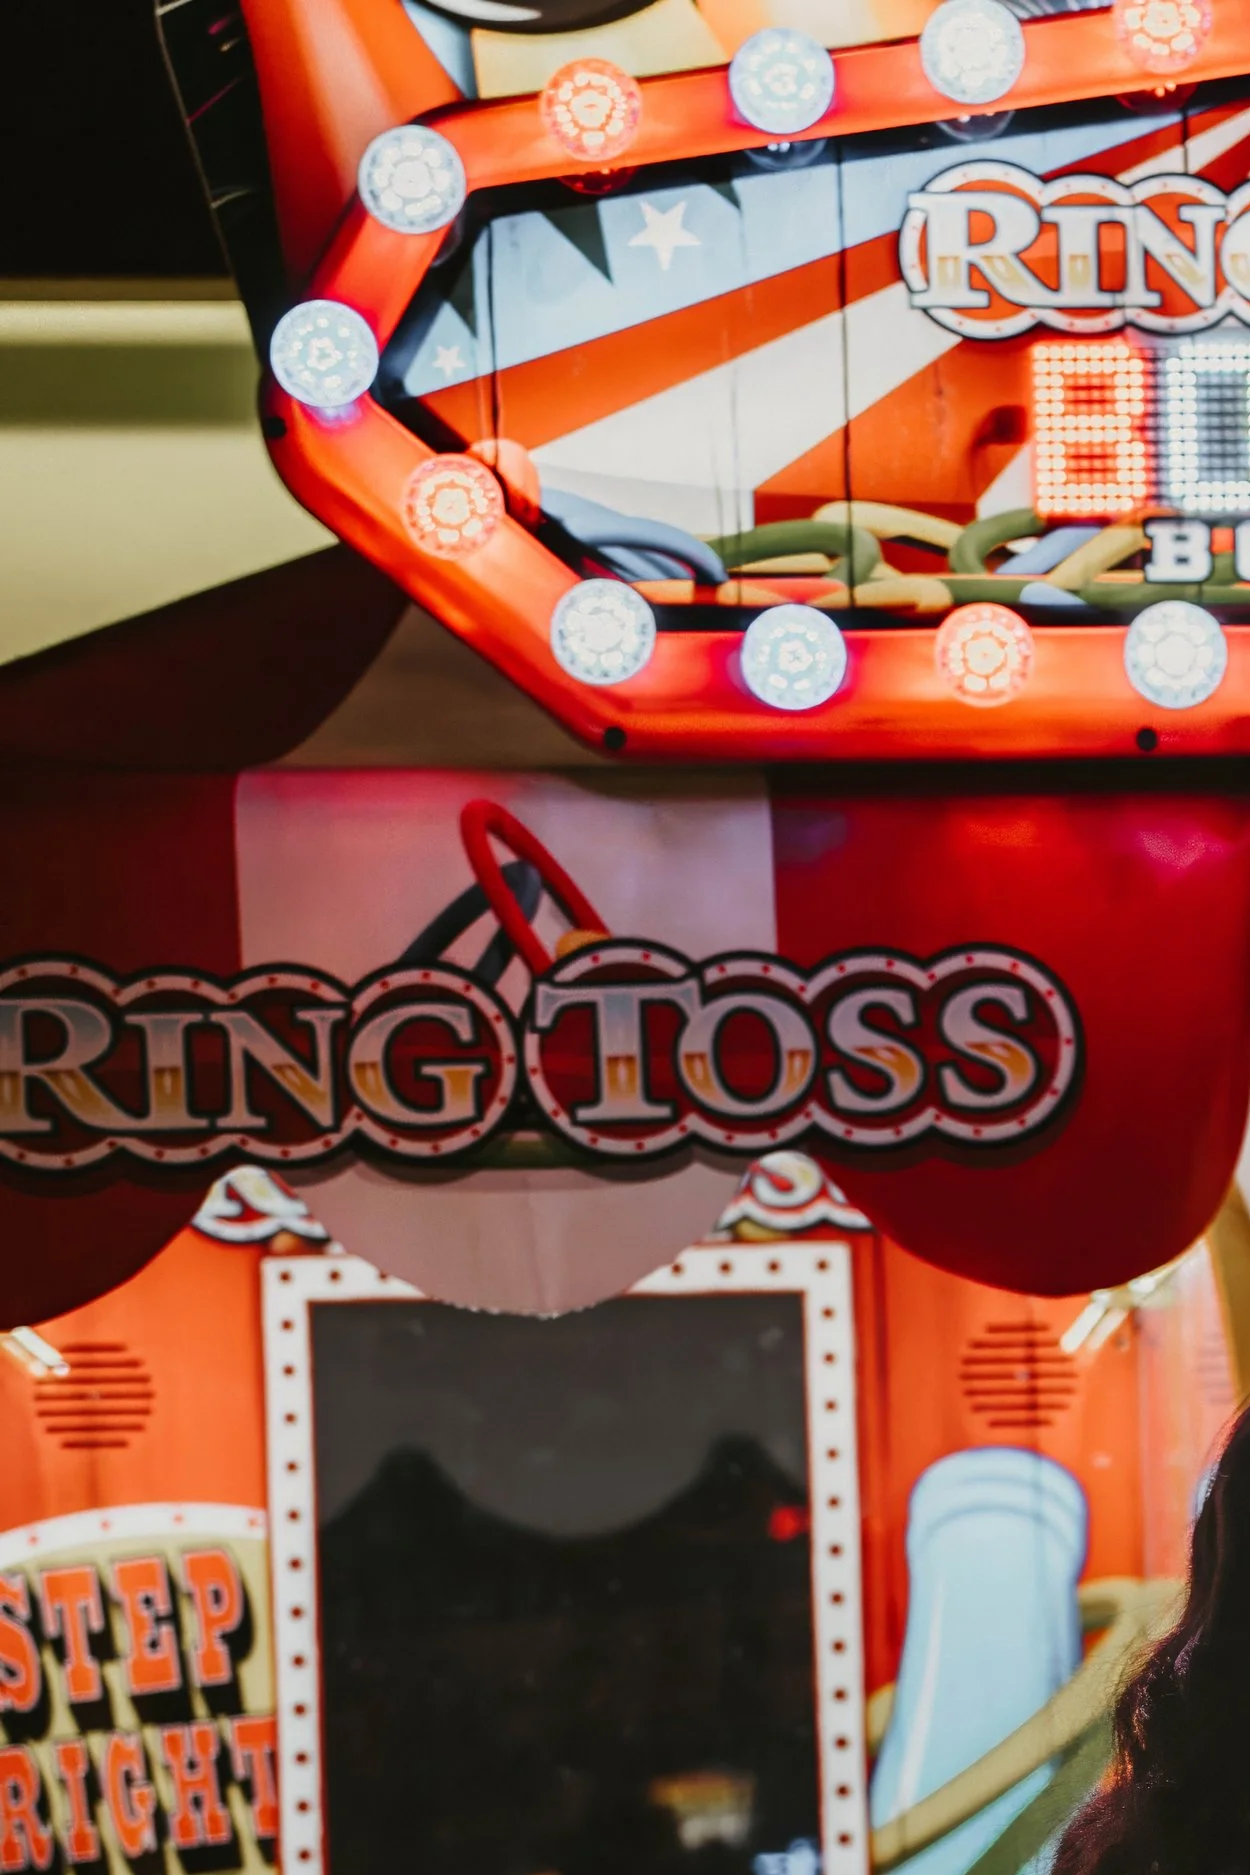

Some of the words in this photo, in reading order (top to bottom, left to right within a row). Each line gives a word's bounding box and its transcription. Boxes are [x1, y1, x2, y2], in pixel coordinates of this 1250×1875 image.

[0, 997, 490, 1136] RING
[535, 978, 1040, 1122] TOSS
[0, 1546, 244, 1713] STEP
[0, 1715, 278, 1872] RIGHT
